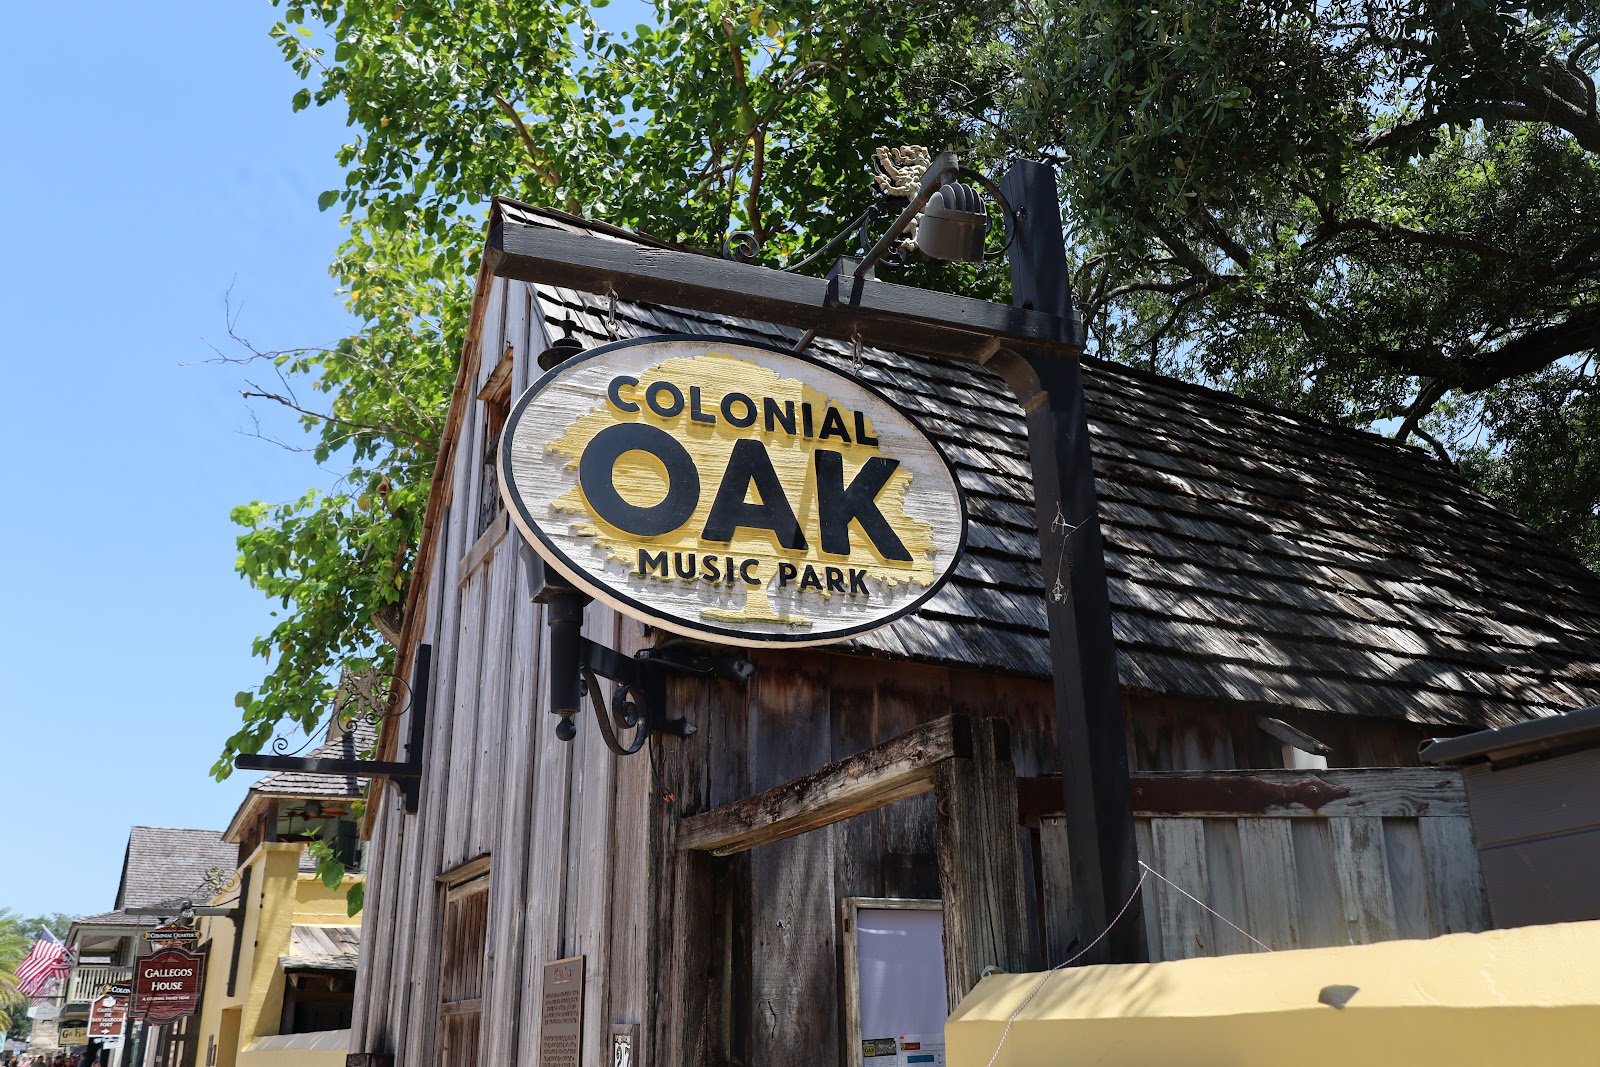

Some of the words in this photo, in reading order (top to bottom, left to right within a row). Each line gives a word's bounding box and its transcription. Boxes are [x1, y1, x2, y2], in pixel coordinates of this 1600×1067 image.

[607, 376, 879, 446] COLONIAL
[579, 422, 914, 562] OAK
[638, 548, 761, 586] MUSIC
[778, 562, 870, 596] PARK
[144, 968, 193, 979] GALLEGOS
[150, 981, 184, 991] HOUSE
